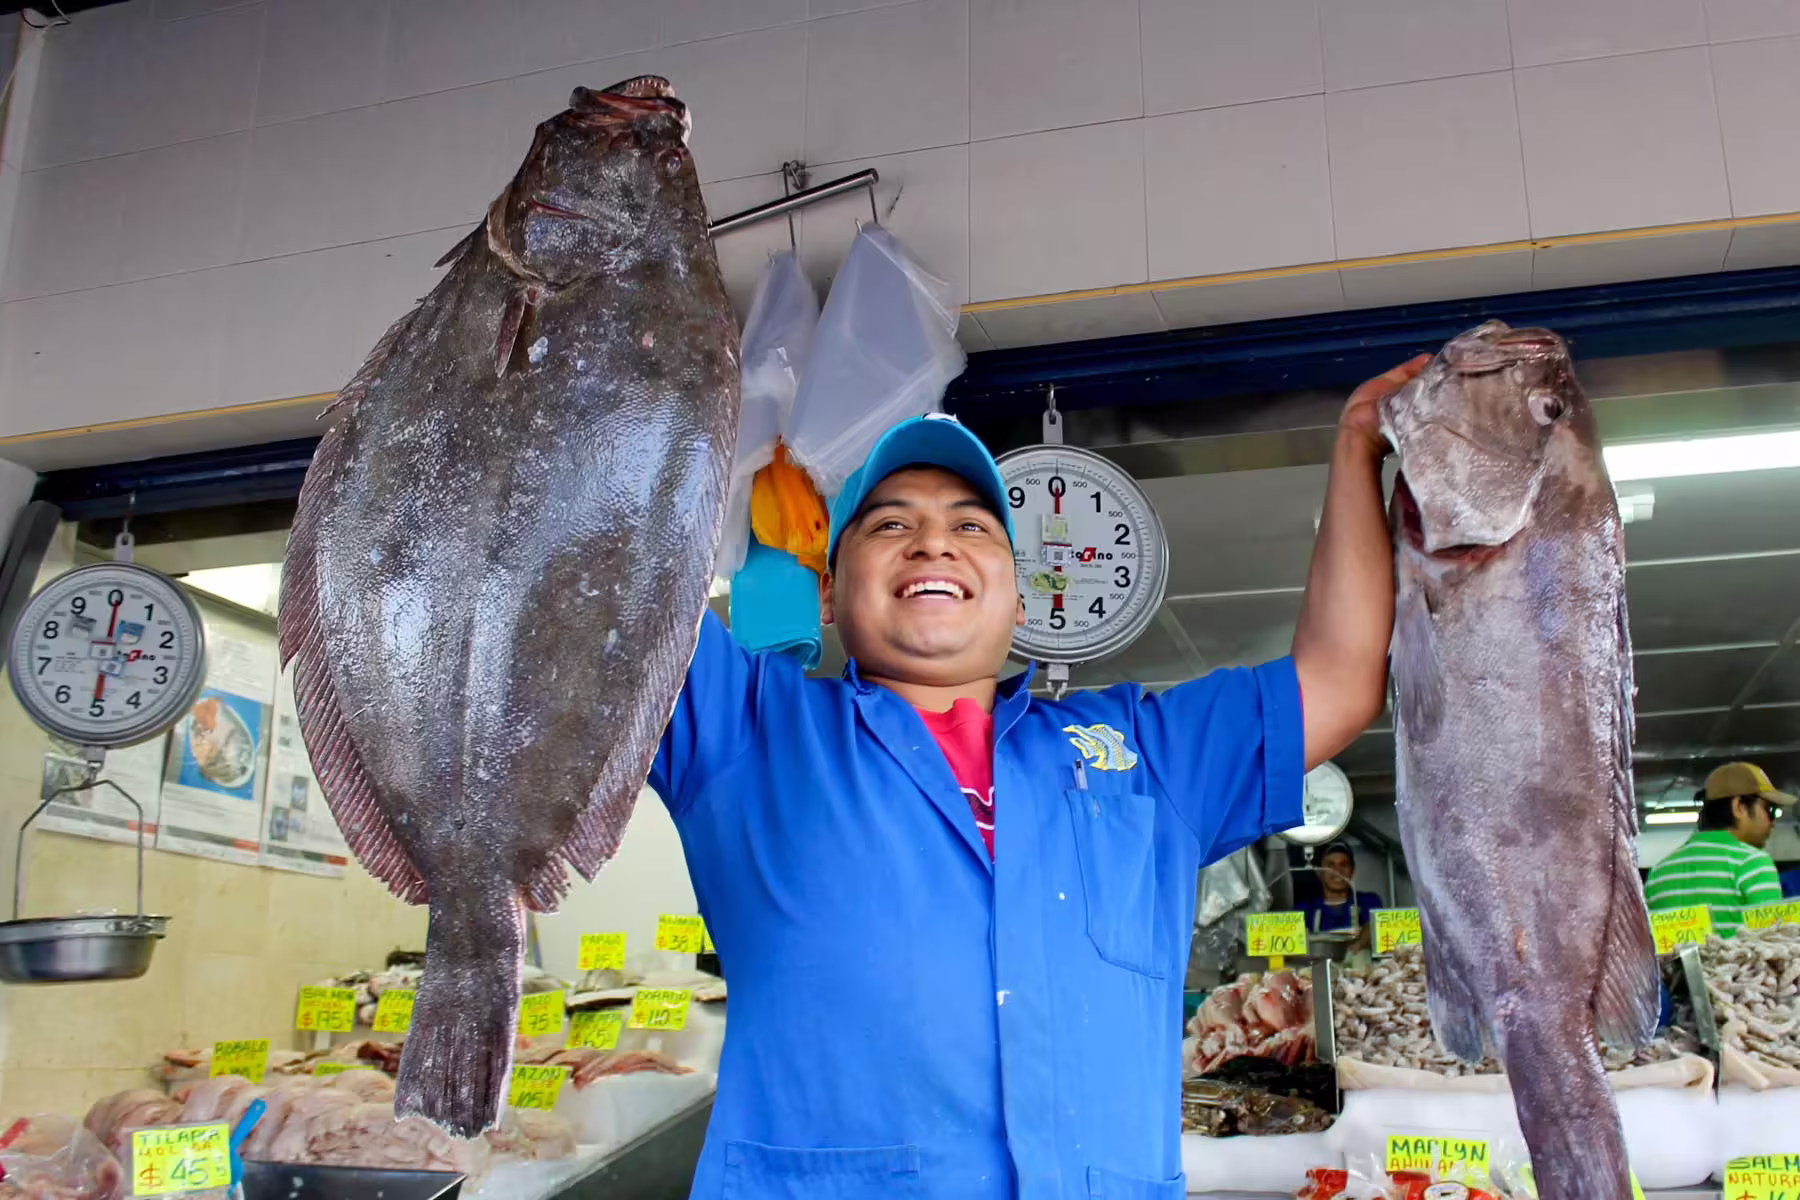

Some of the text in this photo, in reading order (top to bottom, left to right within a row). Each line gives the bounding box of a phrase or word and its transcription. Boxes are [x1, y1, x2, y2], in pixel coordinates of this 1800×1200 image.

[1025, 478, 1041, 486] 500
[1048, 476, 1066, 498] 0
[1008, 486, 1026, 509] 9
[1090, 491, 1102, 513] 1
[1108, 510, 1123, 518] 500
[1114, 523, 1131, 546] 2
[1121, 552, 1136, 560] 500
[1114, 565, 1131, 588] 3
[70, 596, 86, 615] 9
[108, 589, 124, 607] 0
[144, 603, 154, 621] 1
[1088, 596, 1107, 619] 4
[1049, 608, 1067, 630] 5
[1074, 620, 1089, 628] 500
[43, 621, 59, 639] 8
[159, 631, 175, 649] 2
[37, 656, 52, 675] 7
[153, 666, 169, 685] 3
[55, 685, 71, 704] 6
[126, 691, 142, 709] 4
[88, 699, 105, 717] 5
[511, 1065, 561, 1081] AZON
